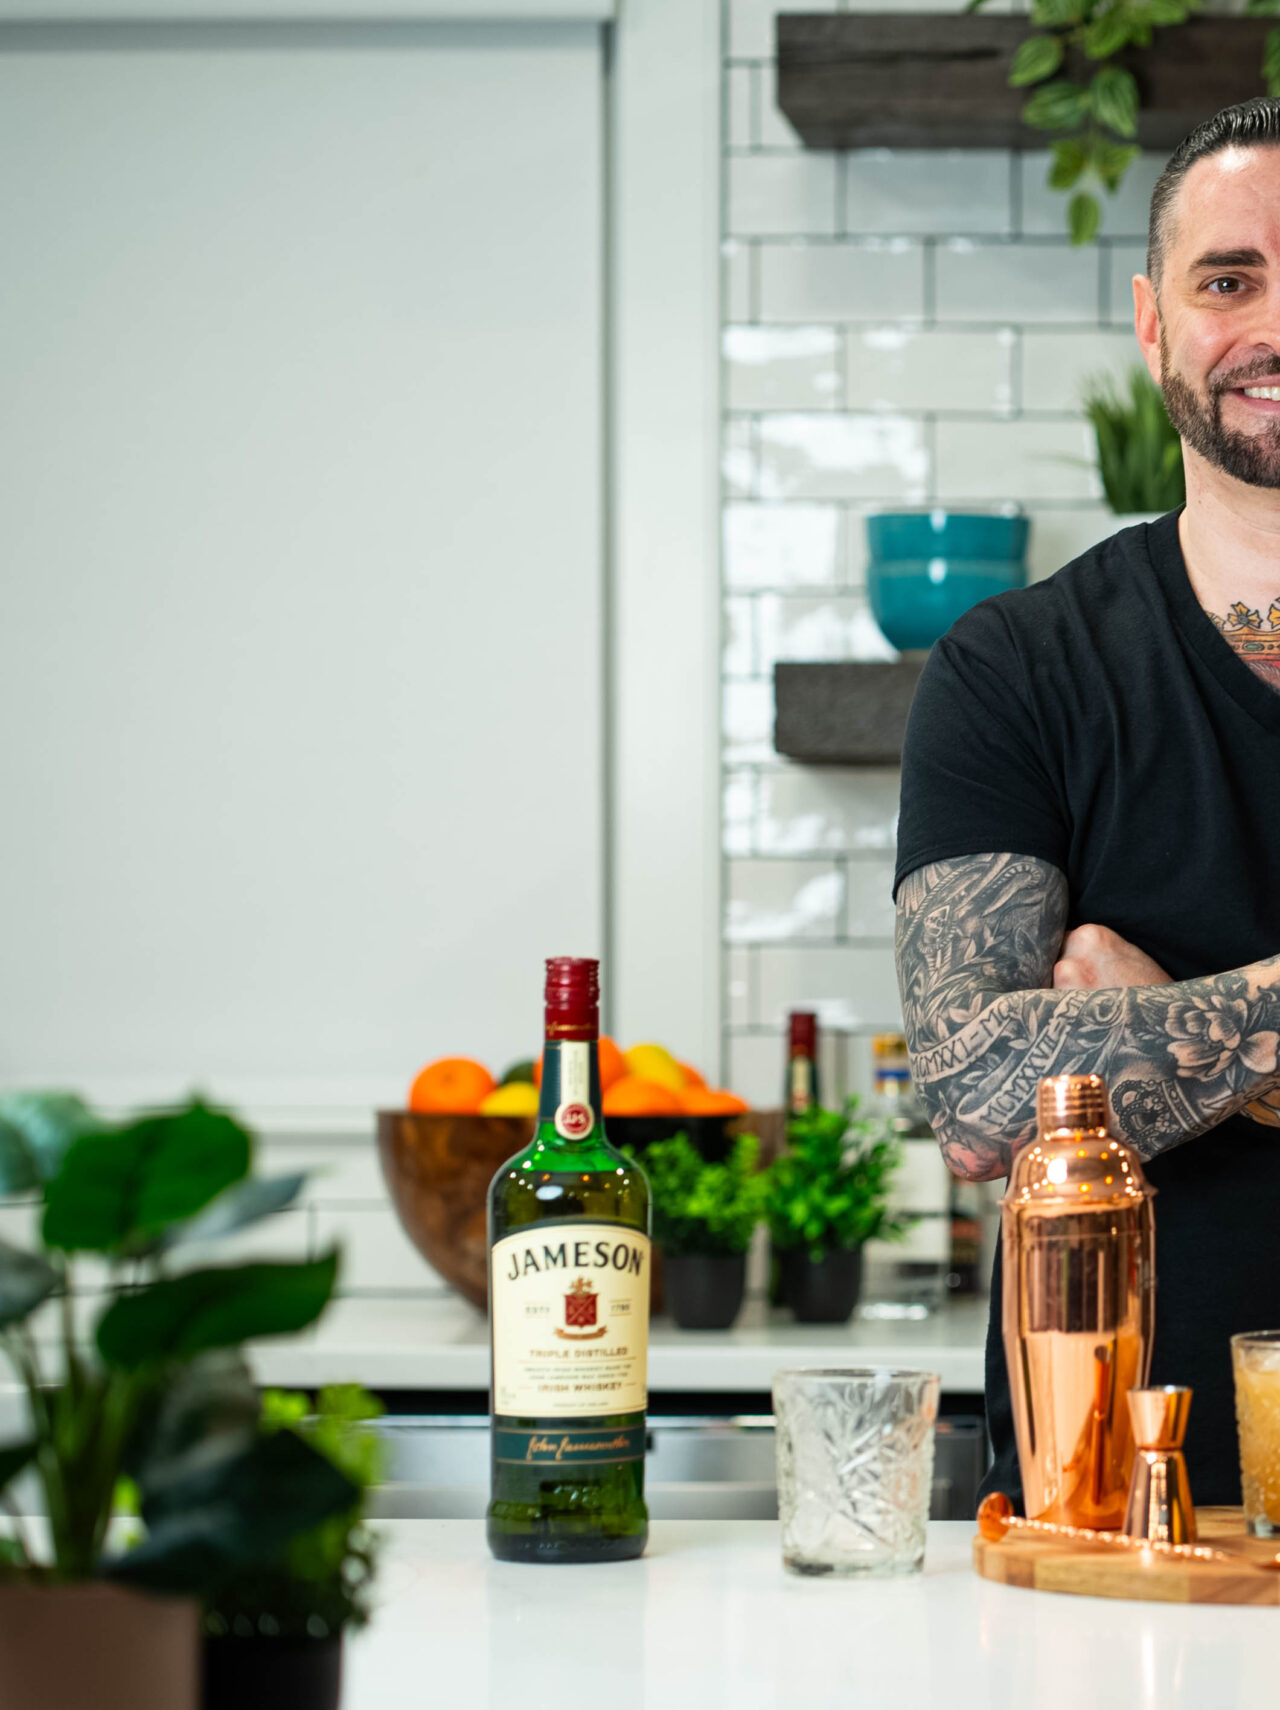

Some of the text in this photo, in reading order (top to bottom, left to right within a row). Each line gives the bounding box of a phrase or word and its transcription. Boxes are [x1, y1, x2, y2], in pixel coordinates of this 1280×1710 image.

[910, 1036, 971, 1079] MCMXXI
[508, 1241, 643, 1280] JAMESON
[529, 1346, 629, 1359] TRIPLE DISTILLED
[538, 1381, 623, 1393] IRISH WHISKEY
